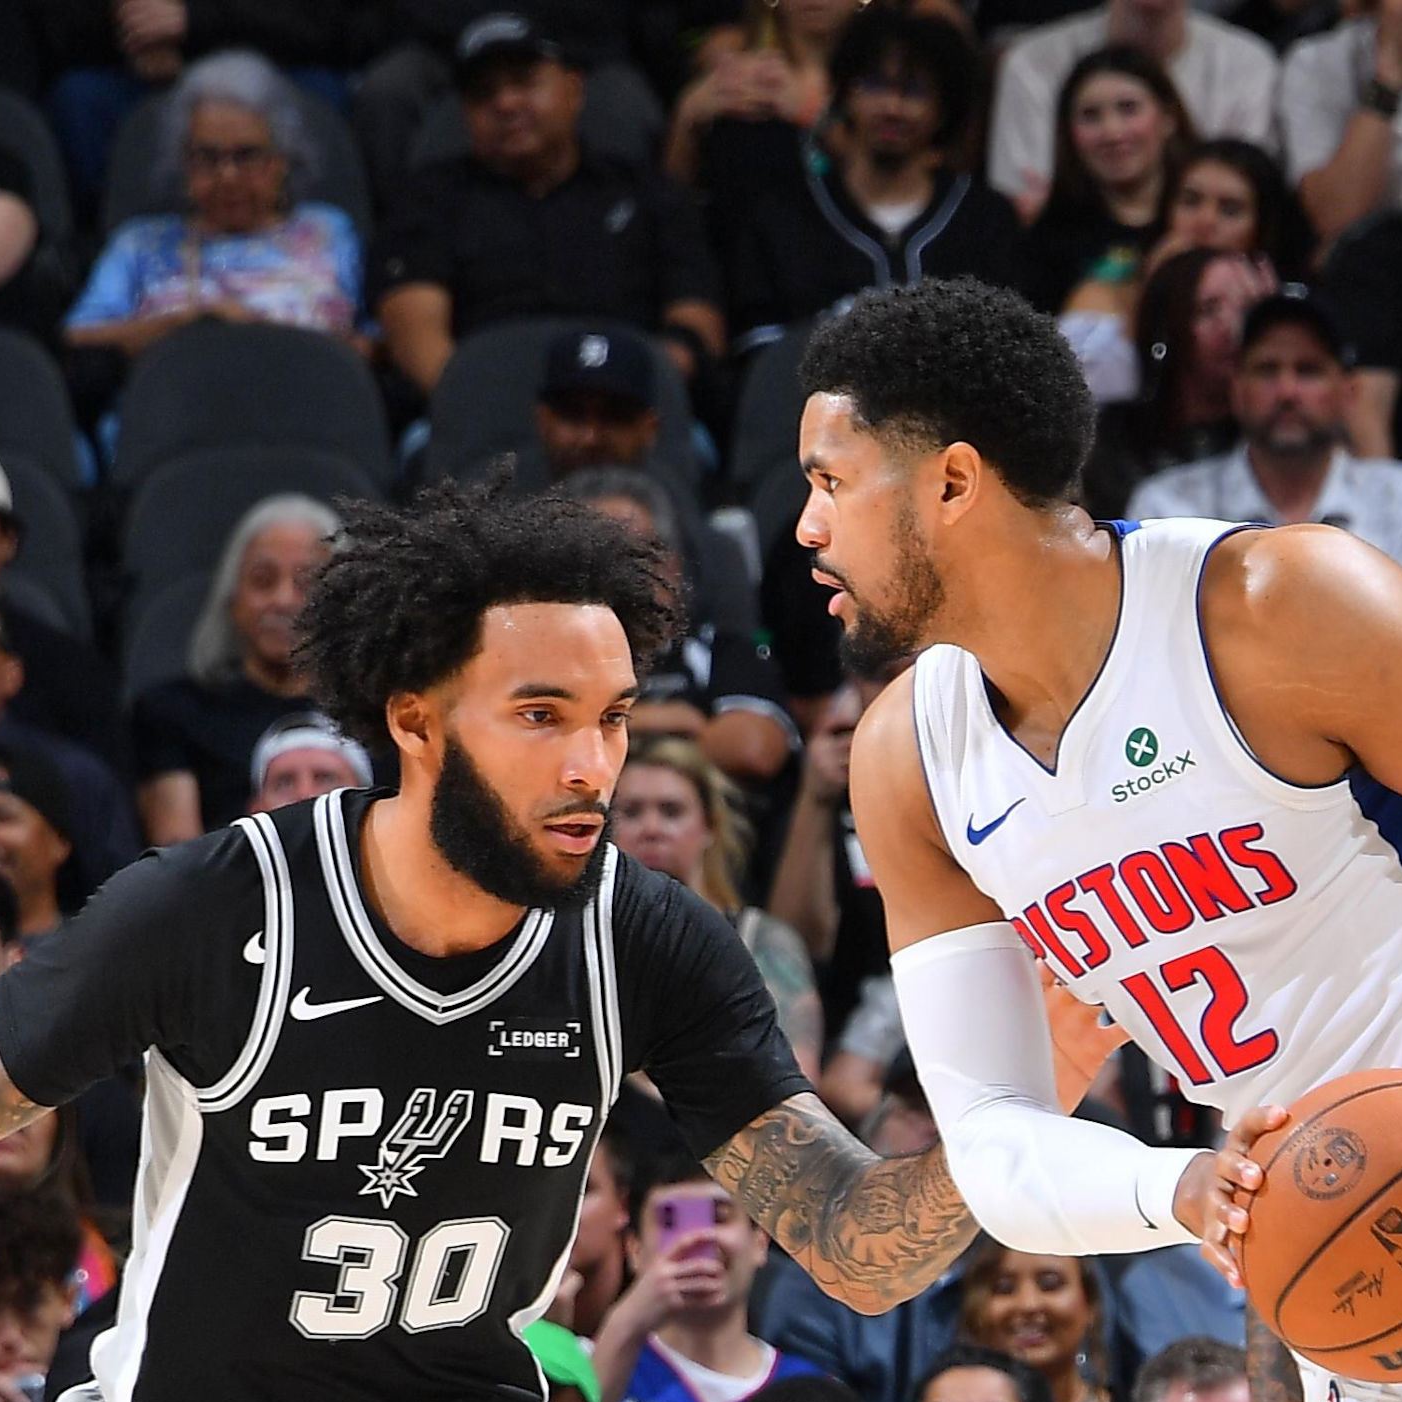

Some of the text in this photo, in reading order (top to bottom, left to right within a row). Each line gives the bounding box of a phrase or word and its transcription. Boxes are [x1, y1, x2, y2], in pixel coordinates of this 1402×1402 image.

[1111, 750, 1197, 802] StockX
[500, 1030, 570, 1048] LEDGER
[1118, 944, 1279, 1086] 12
[248, 1087, 594, 1209] SPURS
[288, 1214, 512, 1340] 30
